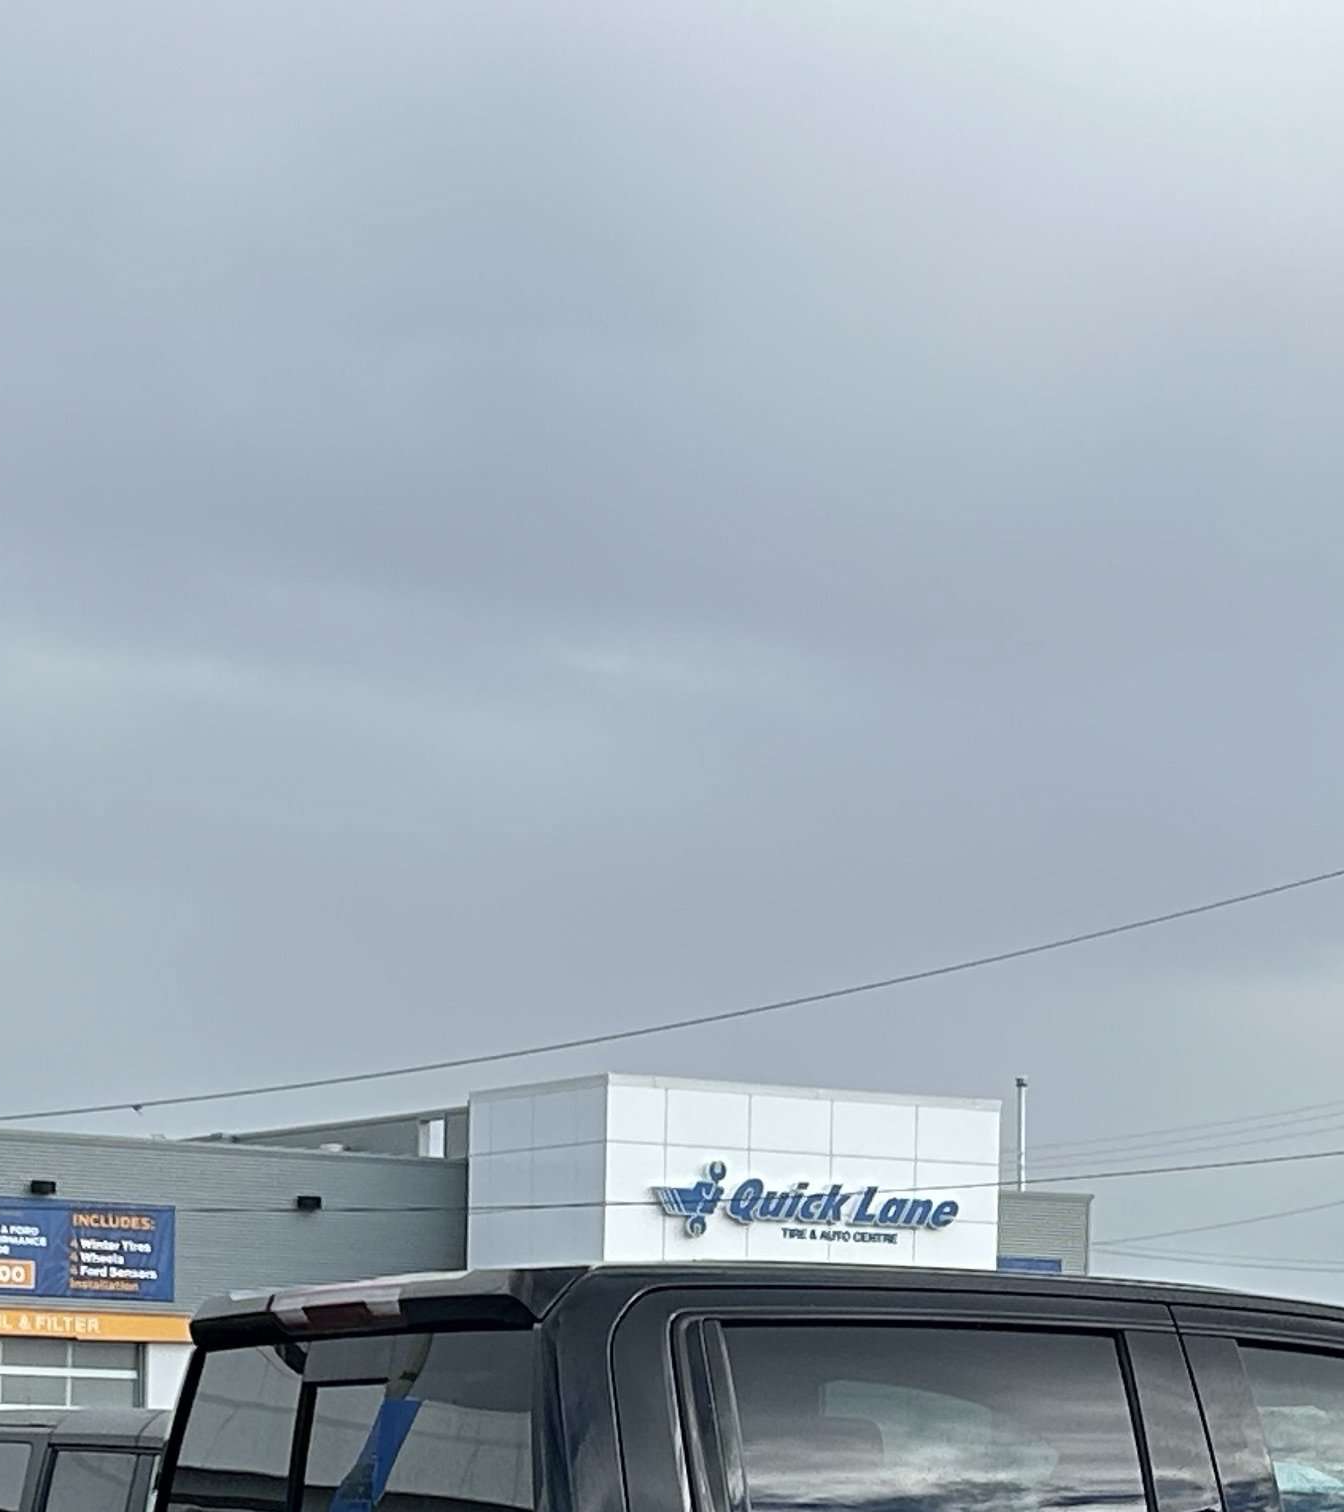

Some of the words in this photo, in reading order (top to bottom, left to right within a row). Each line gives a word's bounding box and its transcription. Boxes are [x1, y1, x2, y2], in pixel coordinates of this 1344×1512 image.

[729, 1178, 851, 1222] Quick
[853, 1186, 959, 1228] Lane
[72, 1213, 156, 1231] INCLUDES:
[0, 1225, 9, 1234] A
[10, 1225, 40, 1236] FORD
[781, 1227, 807, 1240] TIRE
[810, 1229, 817, 1240] &
[819, 1230, 850, 1242] AUTO
[853, 1231, 898, 1244] CENTRE
[80, 1238, 120, 1250] Winter
[121, 1240, 152, 1253] Tires
[80, 1251, 124, 1264] Wheels
[80, 1265, 108, 1277] Ford
[109, 1266, 158, 1280] Sensors
[18, 1313, 33, 1330] &
[35, 1314, 101, 1333] FILTER
